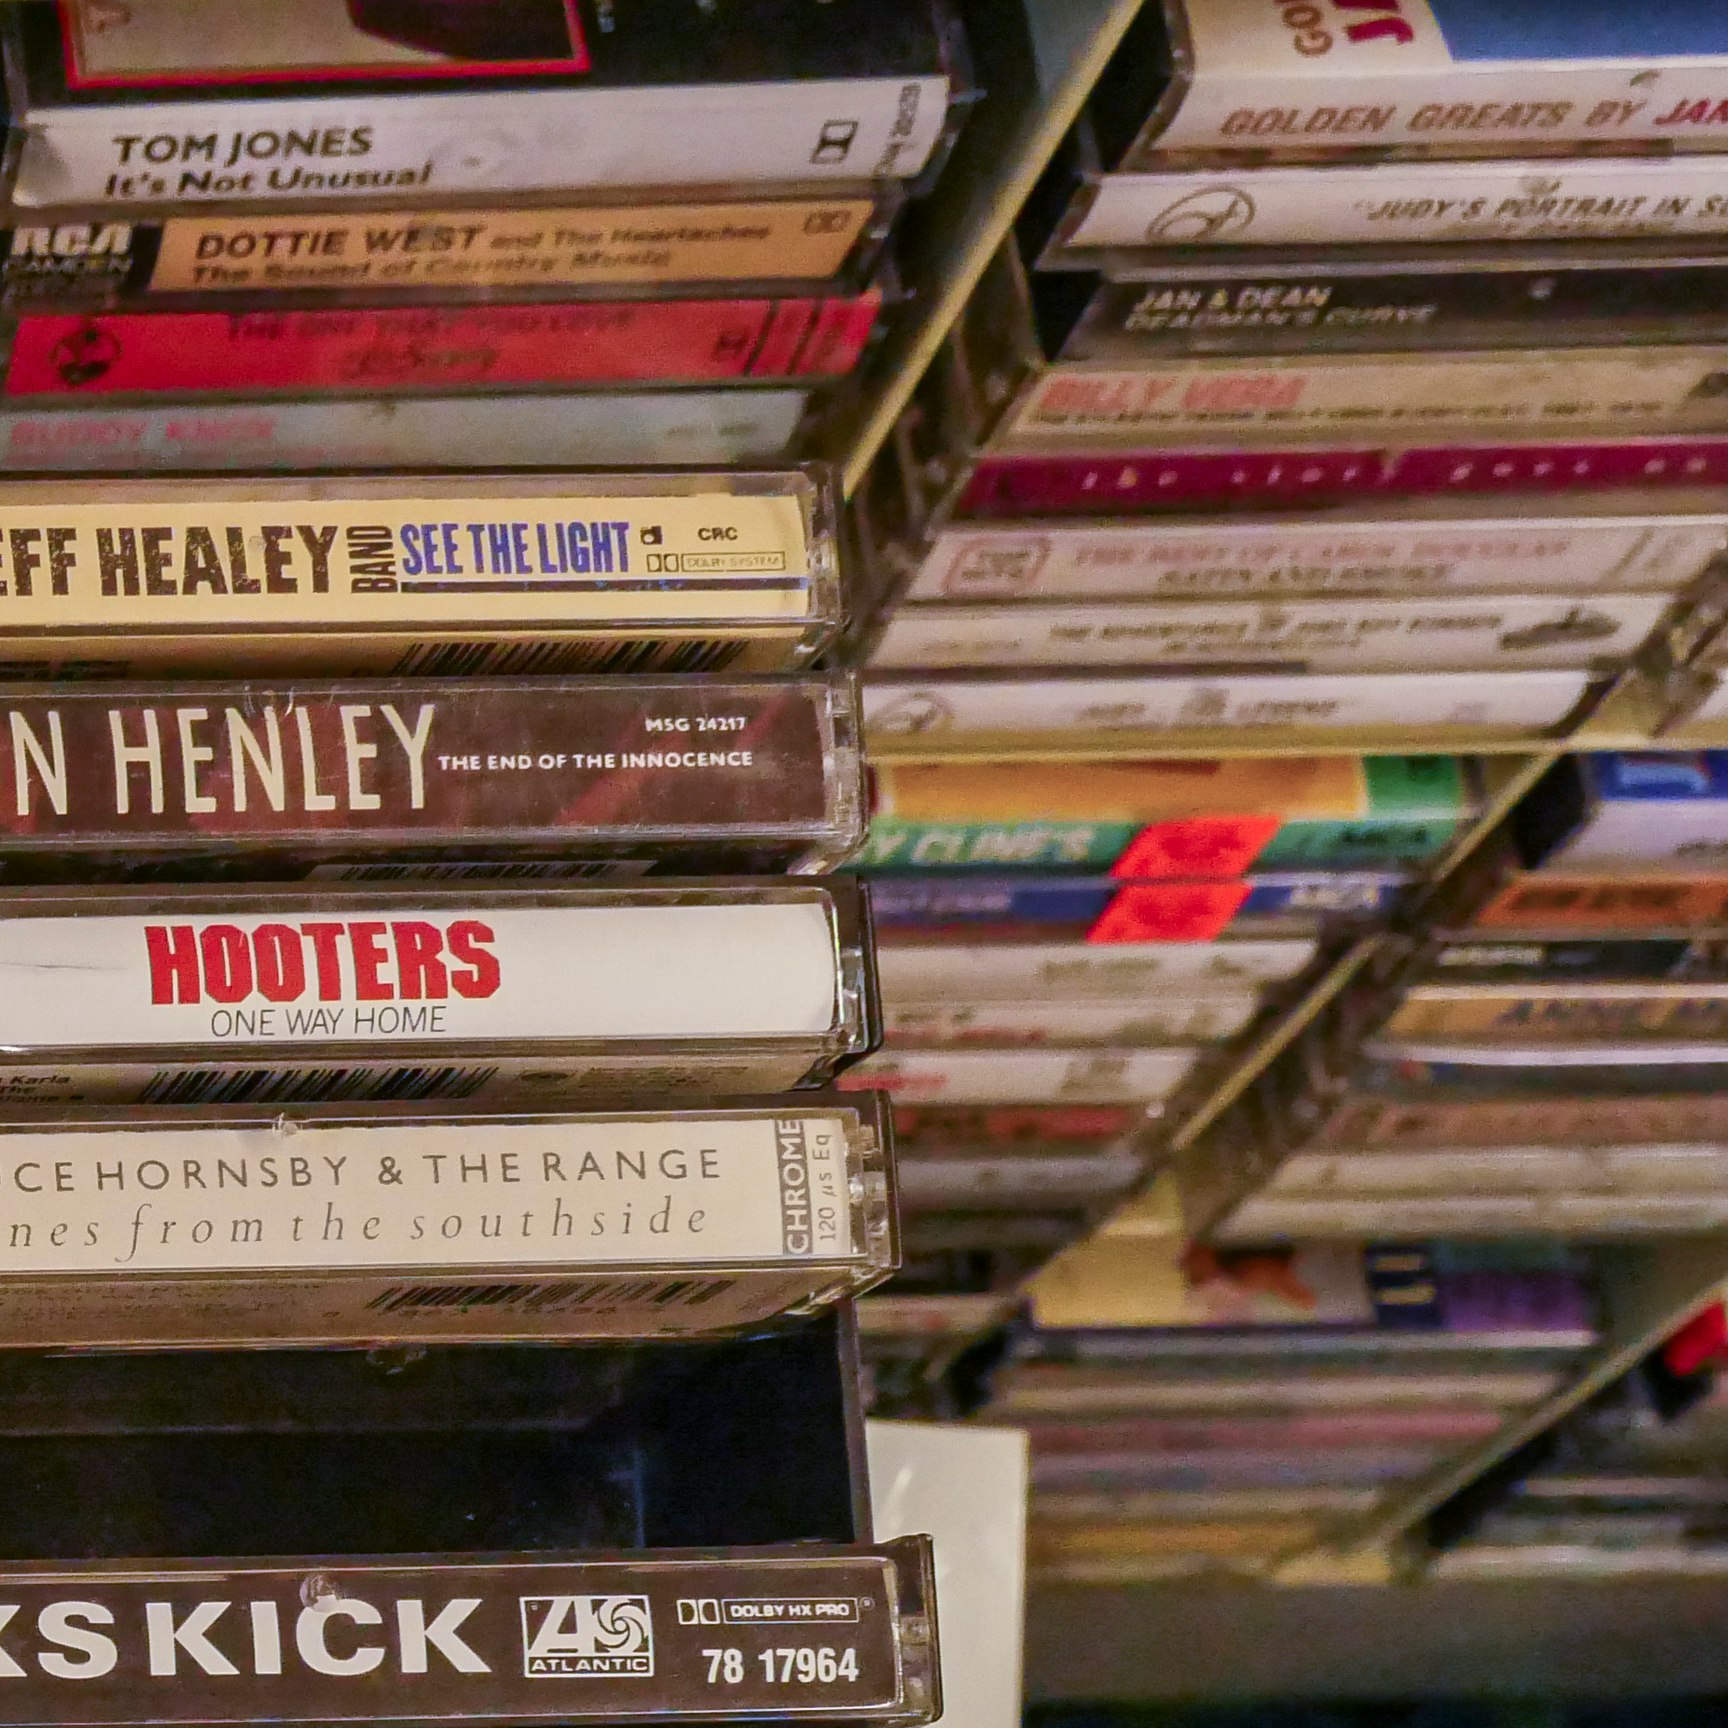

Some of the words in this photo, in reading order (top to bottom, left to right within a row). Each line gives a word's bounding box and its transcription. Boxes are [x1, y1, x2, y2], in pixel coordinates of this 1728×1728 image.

[1220, 104, 1396, 137] GOLDEN
[1405, 101, 1573, 132] GREATS
[1585, 101, 1646, 127] BY
[112, 132, 218, 165] TOM
[225, 126, 374, 166] JONES
[103, 172, 166, 198] It's
[178, 171, 252, 195] Not
[267, 163, 433, 190] Unusual
[195, 229, 348, 259] DOTTIE
[365, 225, 485, 252] WEST
[95, 524, 339, 598] HEALEY
[346, 525, 398, 594] BAND
[401, 522, 463, 577] SEE
[466, 522, 530, 576] THE
[536, 520, 630, 575] LIGHT
[108, 703, 437, 817] HENLEY
[437, 755, 481, 772] THE
[487, 754, 532, 771] END
[537, 753, 569, 770] OF
[574, 752, 616, 769] THE
[621, 749, 754, 769] INNOCENCE
[143, 920, 501, 1007] HOOTERS
[210, 1009, 276, 1038] ONE
[285, 1008, 345, 1035] WAY
[354, 1005, 447, 1034] HOME
[96, 1156, 348, 1192] HORNSBY
[378, 1157, 403, 1186] &
[423, 1153, 522, 1185] THE
[543, 1148, 722, 1182] RANGE
[145, 1597, 493, 1678] KICK
[701, 1650, 744, 1685] 78
[761, 1647, 860, 1683] 17964
